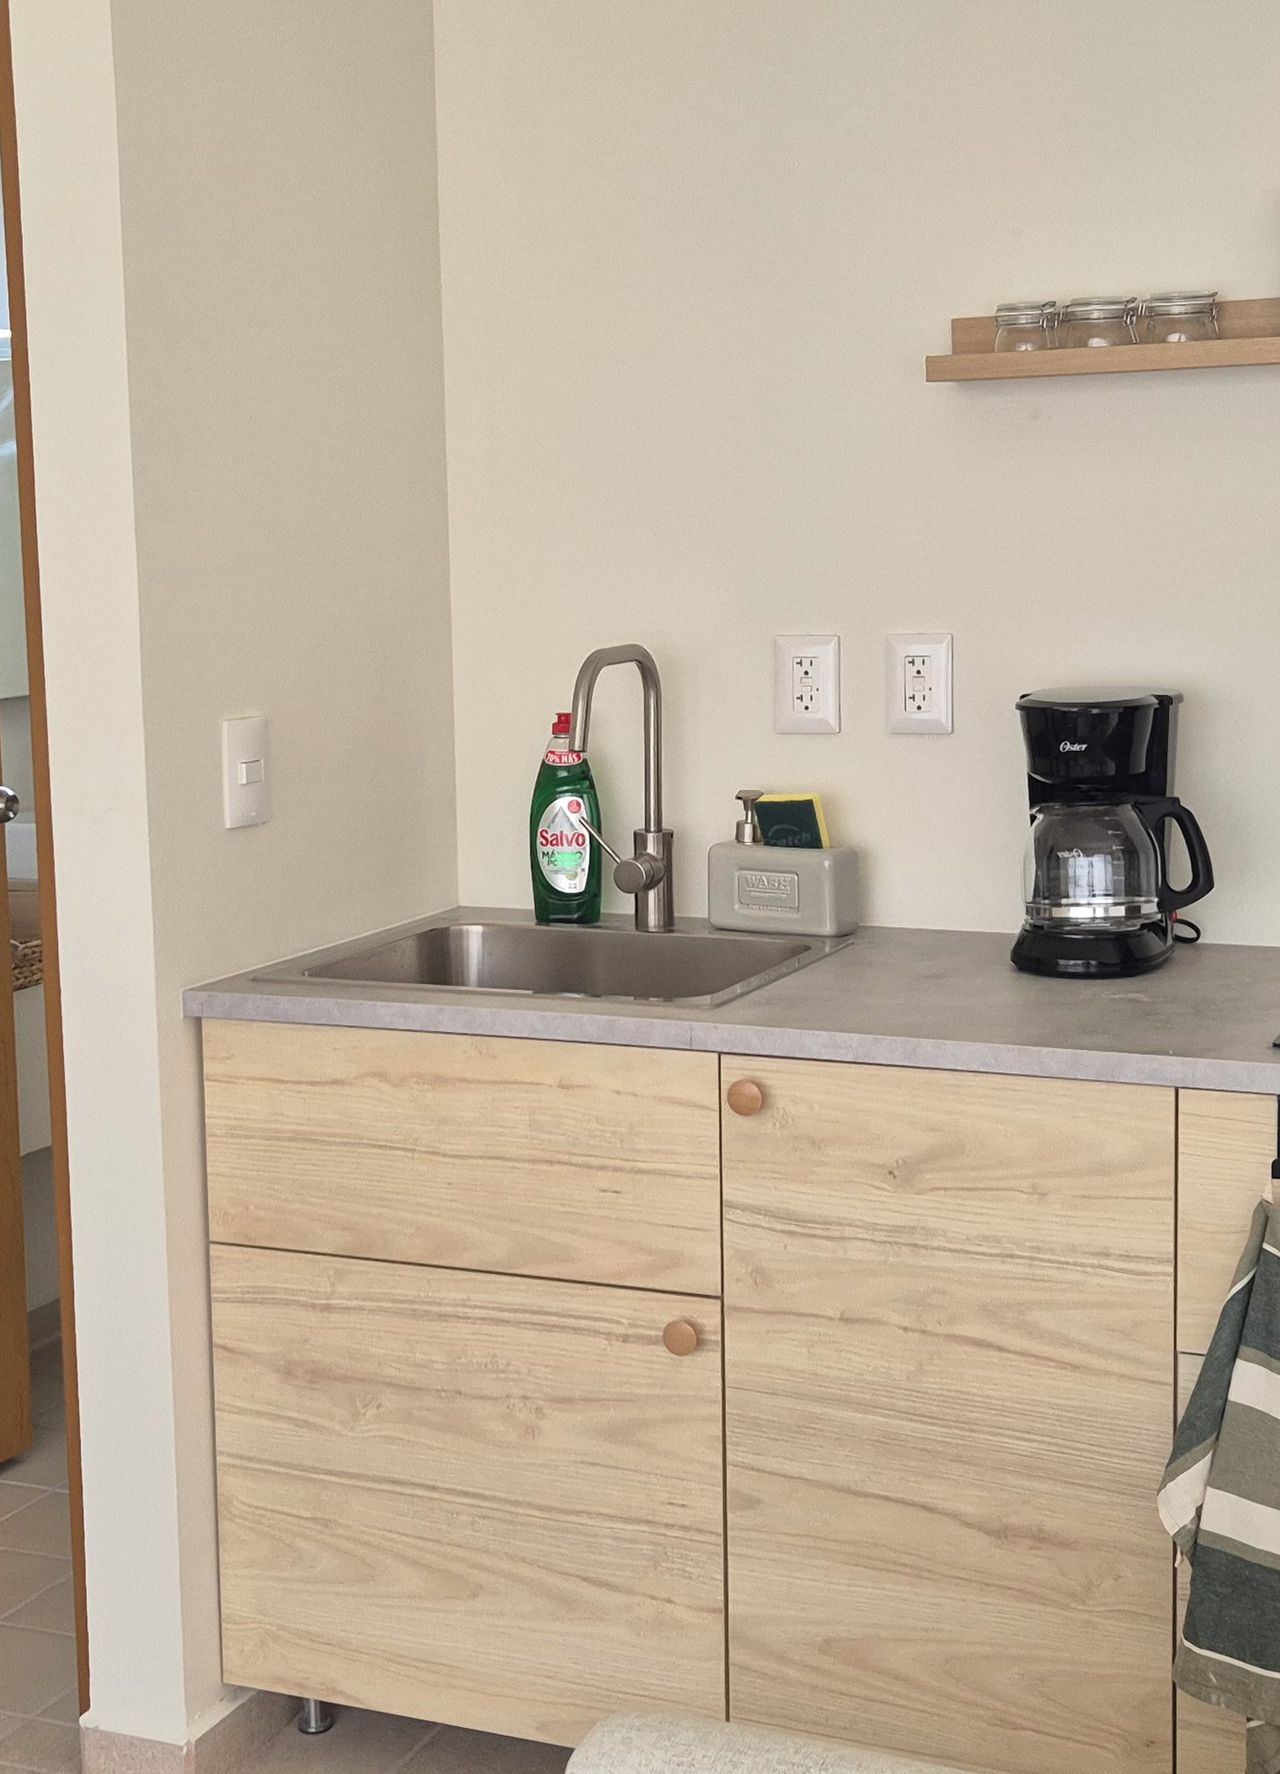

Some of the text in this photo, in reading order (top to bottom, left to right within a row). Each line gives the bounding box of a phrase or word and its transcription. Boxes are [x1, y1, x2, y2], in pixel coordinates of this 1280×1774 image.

[1059, 740, 1088, 752] Oster
[539, 829, 586, 847] Salvo
[744, 874, 791, 891] WASH
